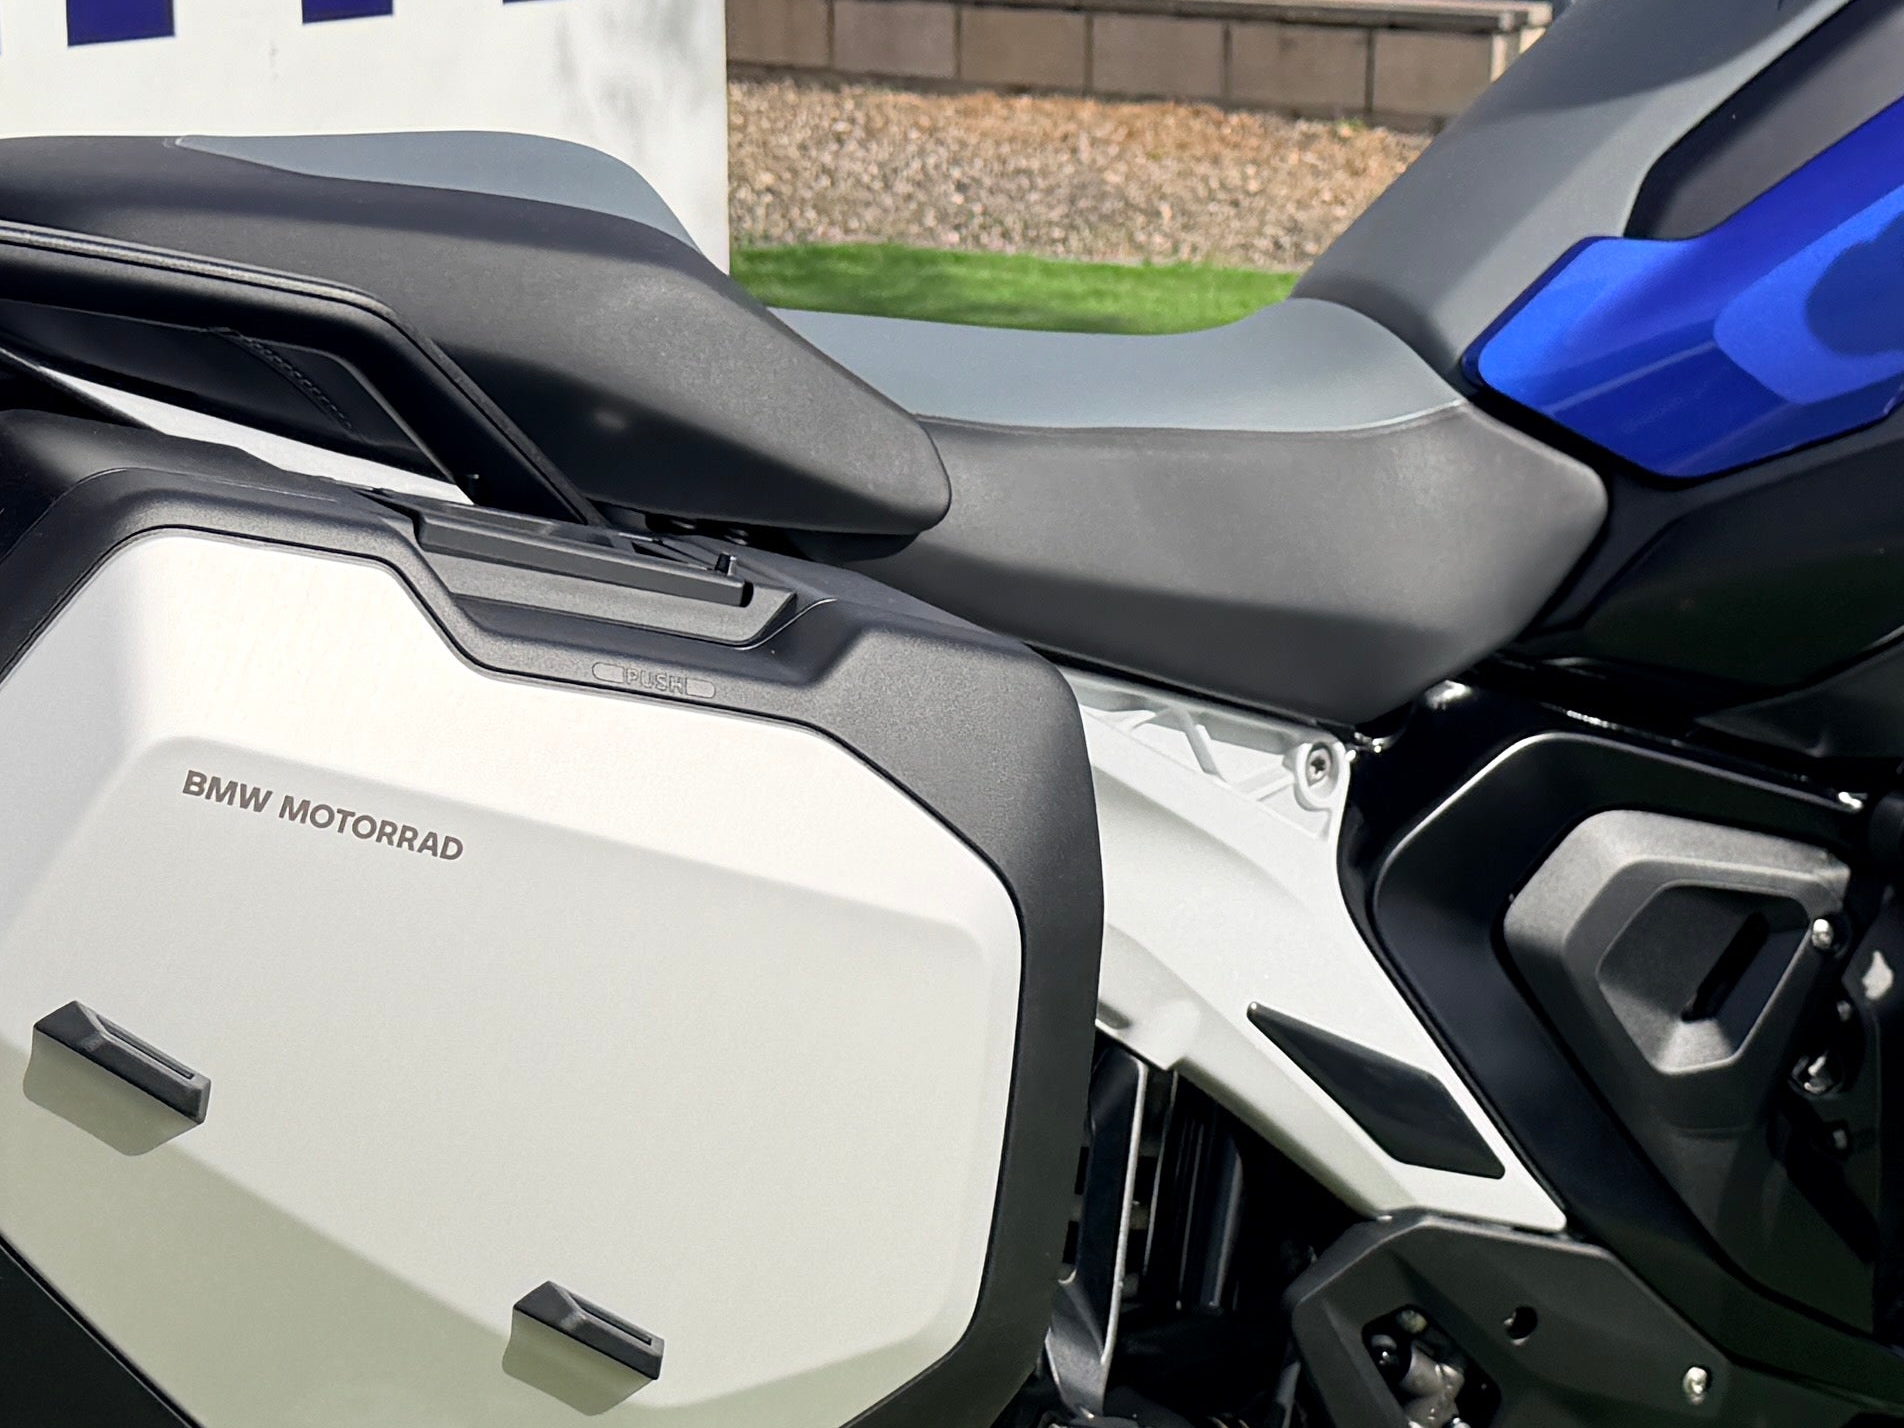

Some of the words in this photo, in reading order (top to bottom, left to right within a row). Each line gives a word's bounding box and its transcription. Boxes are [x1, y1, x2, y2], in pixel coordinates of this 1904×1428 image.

[625, 666, 684, 695] PUSH
[182, 770, 273, 813] BMW
[278, 795, 465, 861] MOTORRAD
